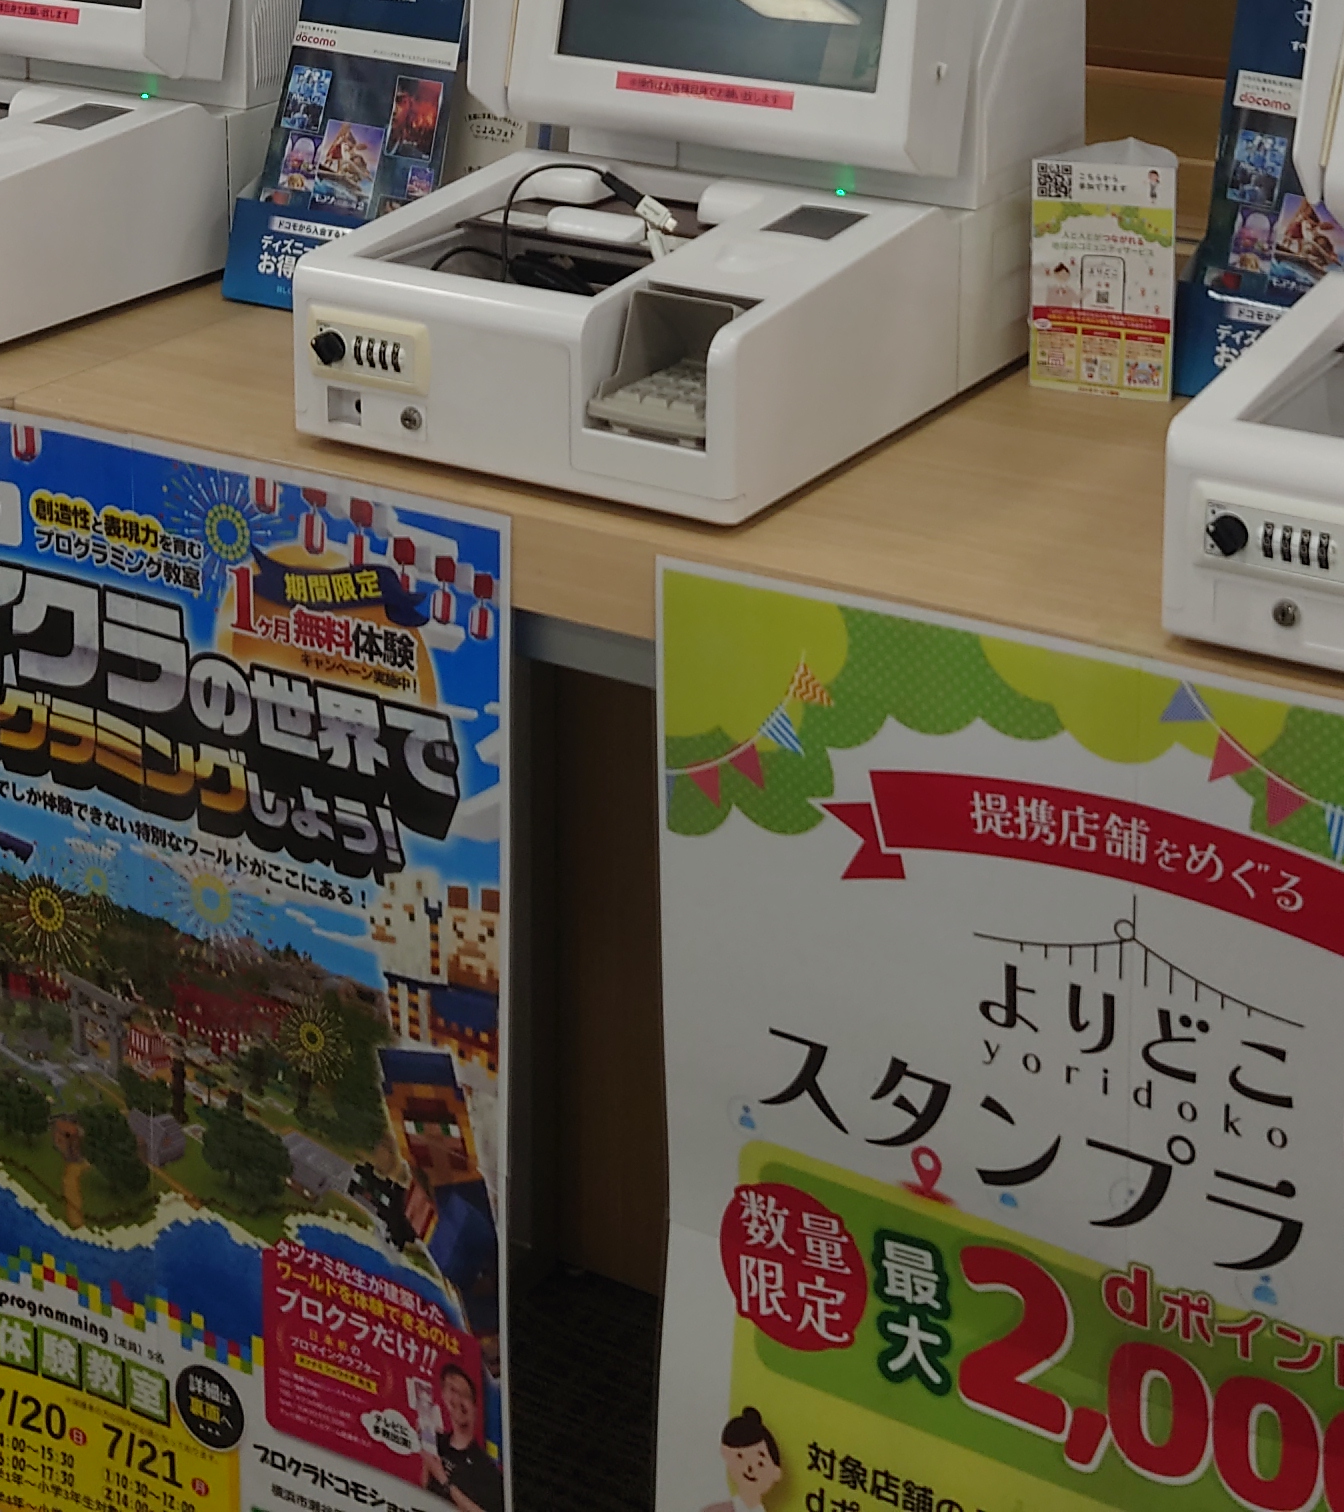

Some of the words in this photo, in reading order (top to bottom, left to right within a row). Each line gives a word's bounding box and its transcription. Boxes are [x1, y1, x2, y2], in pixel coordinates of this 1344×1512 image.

[295, 31, 337, 48] docomo
[1239, 90, 1292, 112] docomo
[36, 498, 203, 560] 創造性と表現力を育む
[36, 529, 203, 592] プログラミング教室
[230, 565, 416, 672] 1ヶ月無料体験
[284, 569, 383, 603] 期間限定
[300, 654, 419, 694] キャンペーン実施中!
[969, 788, 1306, 916] 提携店舗をめぐる
[977, 961, 1294, 1109] よりどこ
[983, 1034, 1290, 1152] yoridoko
[736, 1191, 853, 1279] 数量
[0, 1290, 109, 1344] programming
[276, 1238, 446, 1327] タツナミ先生が建築した
[276, 1262, 462, 1356] ワールドを体験できるのは
[738, 1256, 853, 1348] 限定
[879, 1235, 948, 1391] 最大
[188, 1373, 232, 1407] 詳細は
[102, 1421, 183, 1490] 7/21
